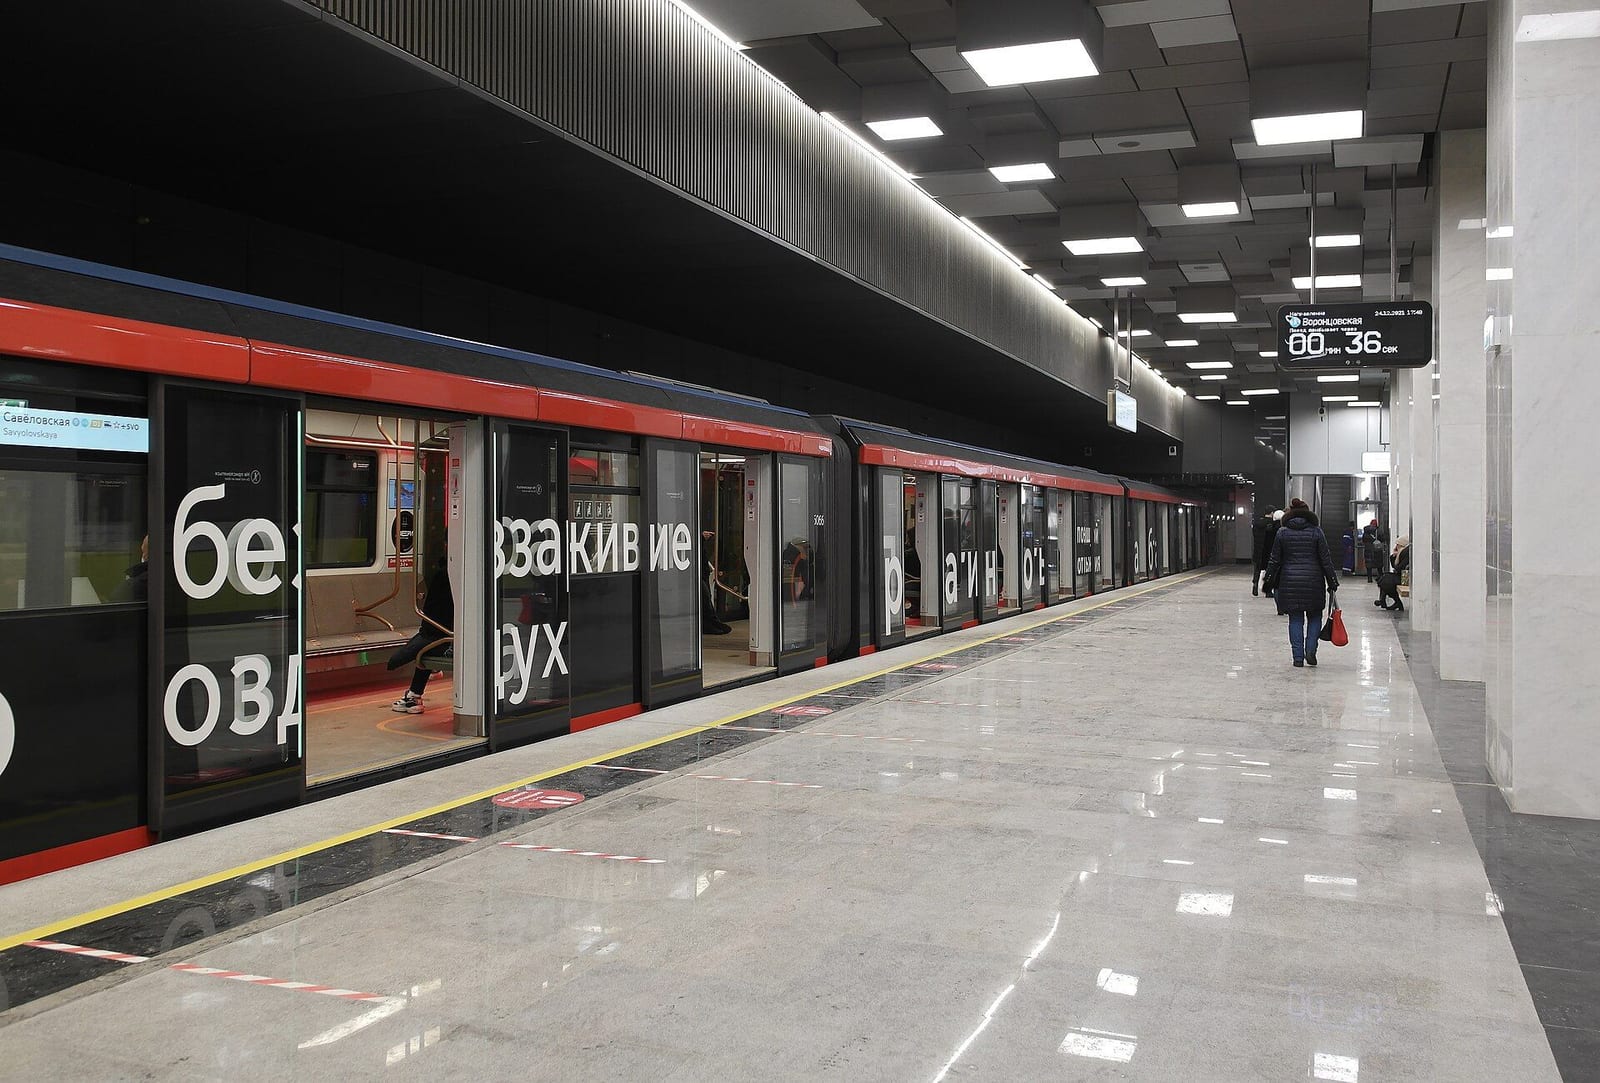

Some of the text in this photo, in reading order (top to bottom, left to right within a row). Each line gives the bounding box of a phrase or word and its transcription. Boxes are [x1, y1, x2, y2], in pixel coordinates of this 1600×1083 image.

[1302, 317, 1362, 327] Воронцовская
[1288, 330, 1399, 355] 00 мин 36 сек
[3, 411, 70, 427] Савёловская
[3, 427, 58, 440] Savyolovskaya
